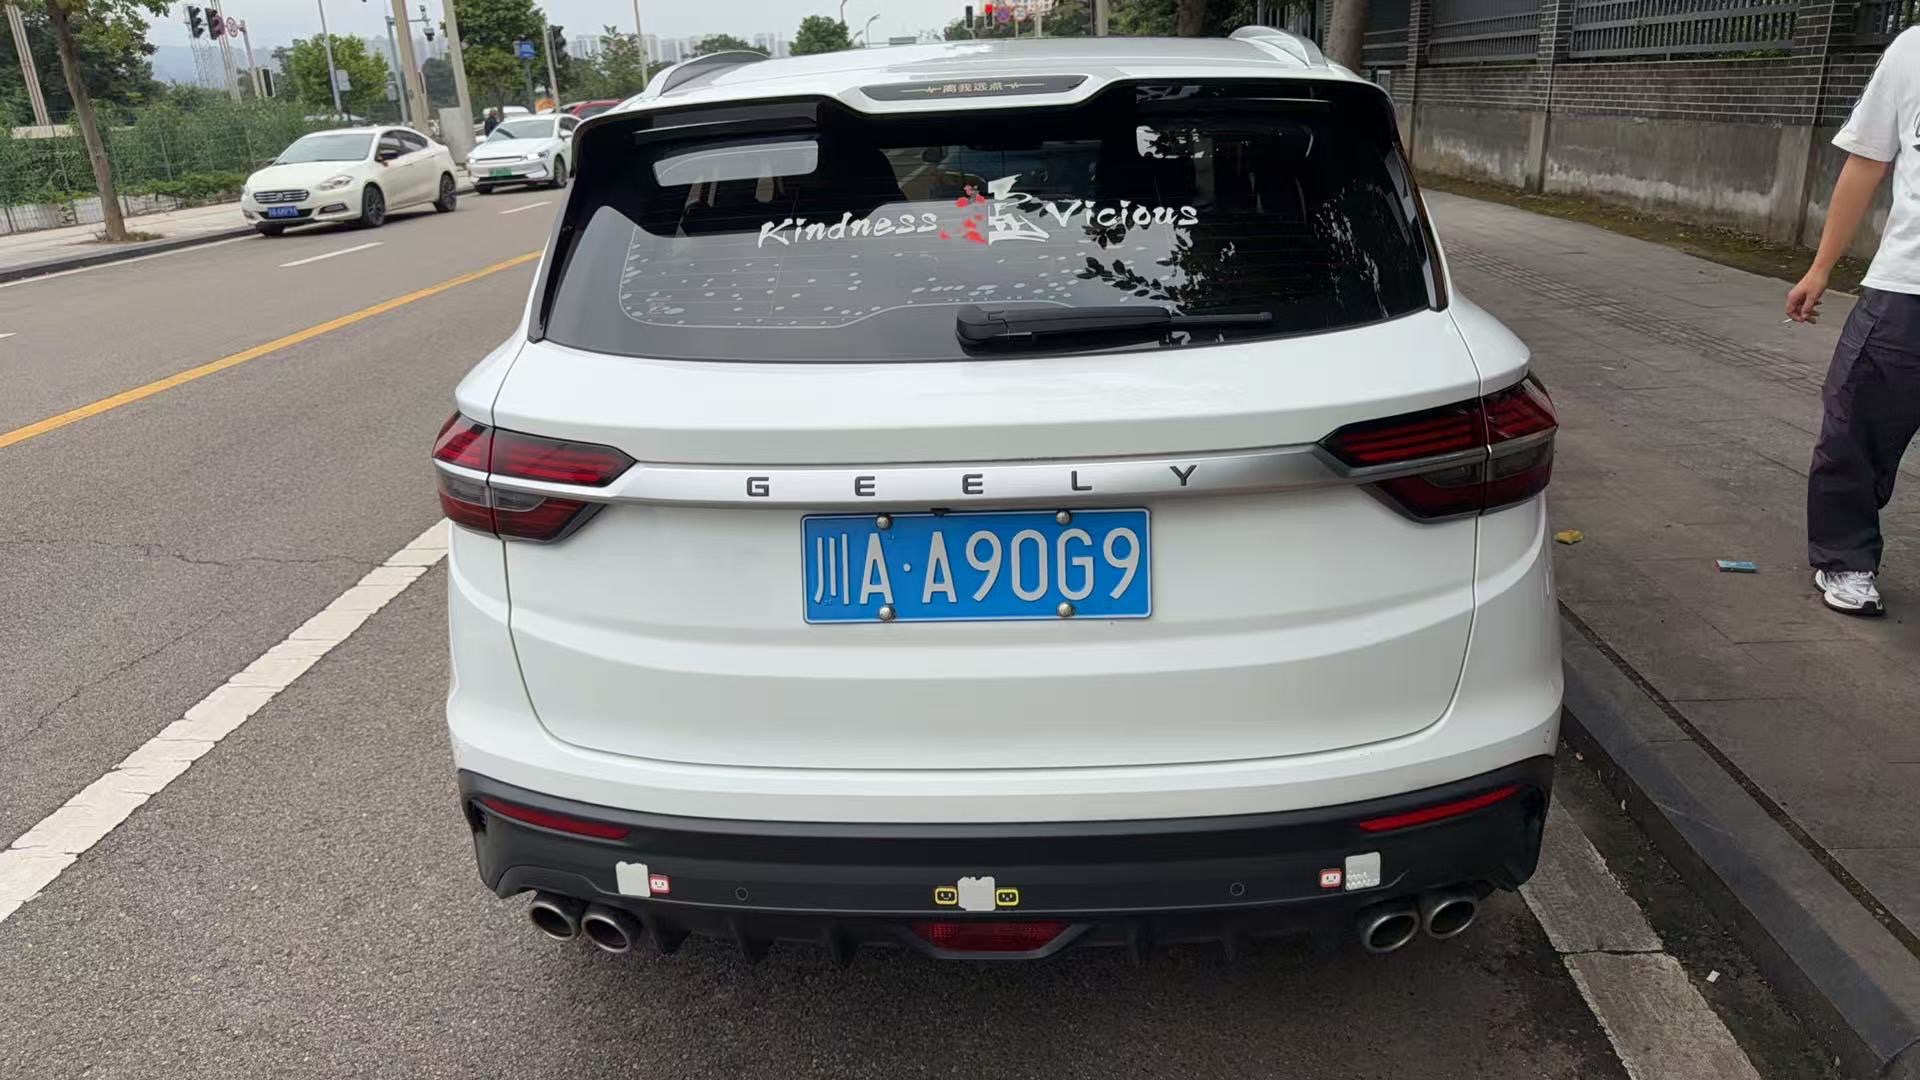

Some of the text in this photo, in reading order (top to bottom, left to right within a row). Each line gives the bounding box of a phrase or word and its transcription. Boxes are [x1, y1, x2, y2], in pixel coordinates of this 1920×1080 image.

[758, 212, 937, 248] Kindness
[1045, 199, 1199, 227] Vicious
[745, 464, 1197, 497] GEELY
